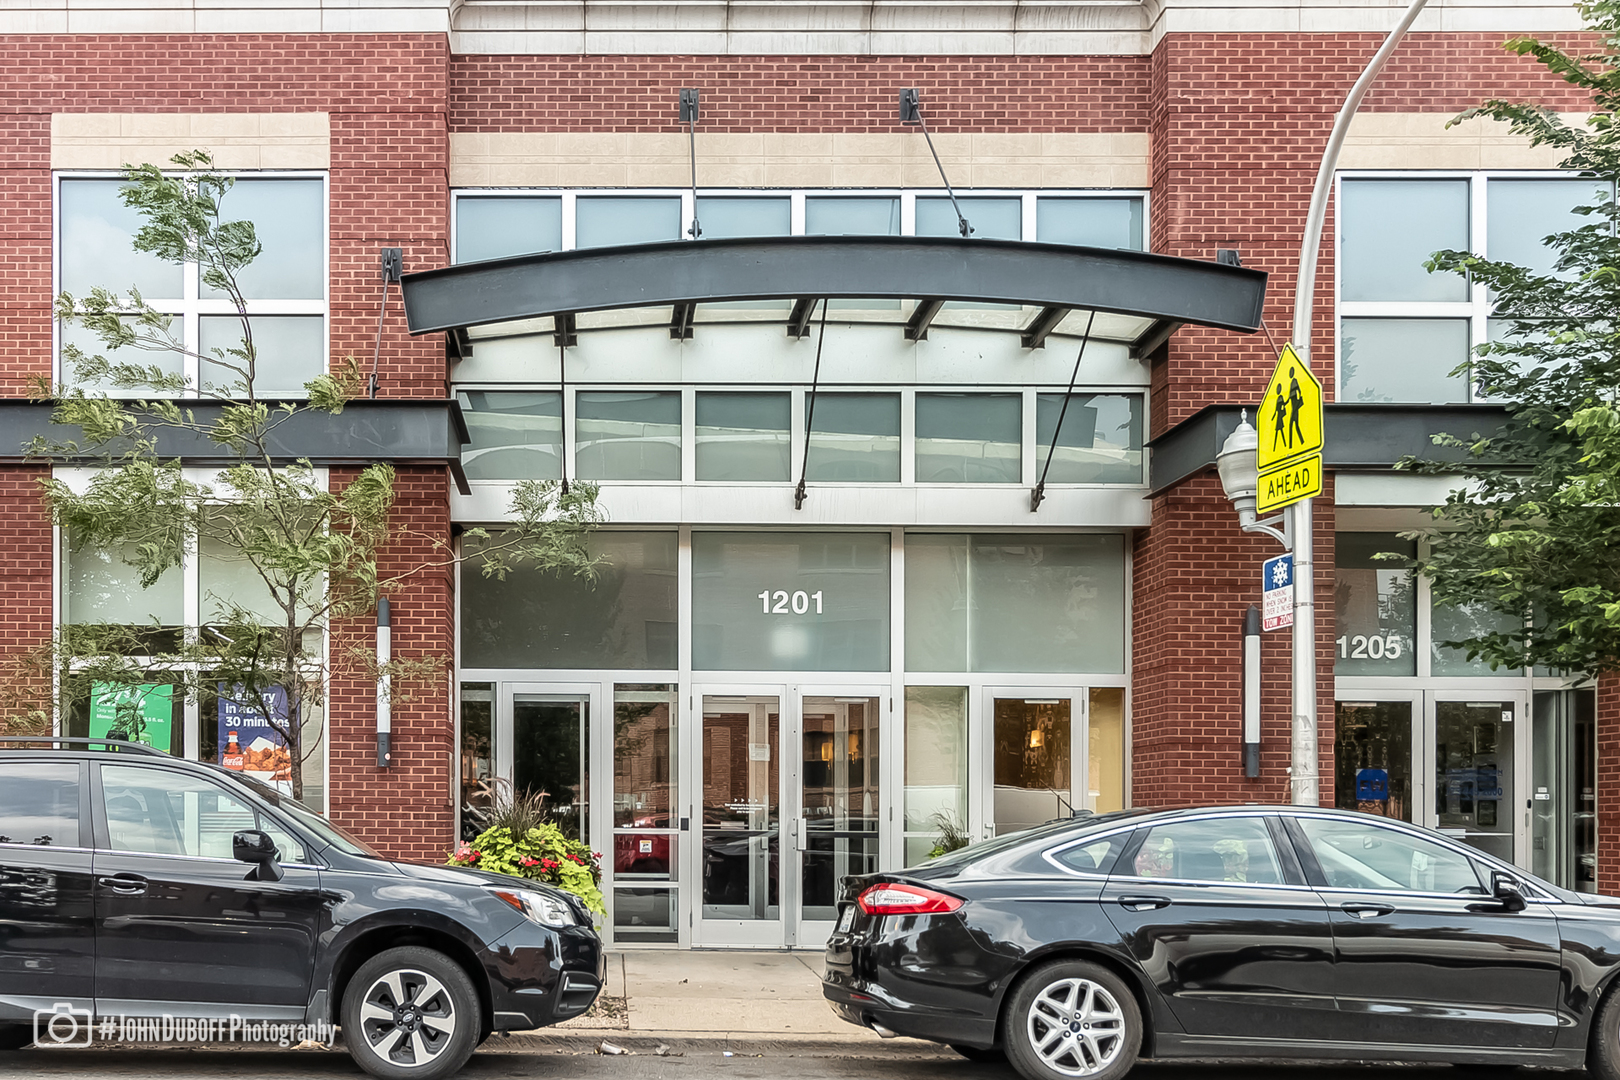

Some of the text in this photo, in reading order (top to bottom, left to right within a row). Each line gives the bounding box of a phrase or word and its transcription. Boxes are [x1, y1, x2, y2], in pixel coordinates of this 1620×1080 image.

[1267, 468, 1310, 500] AHEAD
[758, 590, 823, 614] 1201
[1266, 613, 1293, 628] TOW ZON
[1336, 635, 1401, 659] 1205
[225, 703, 237, 714] in
[225, 716, 241, 727] 30
